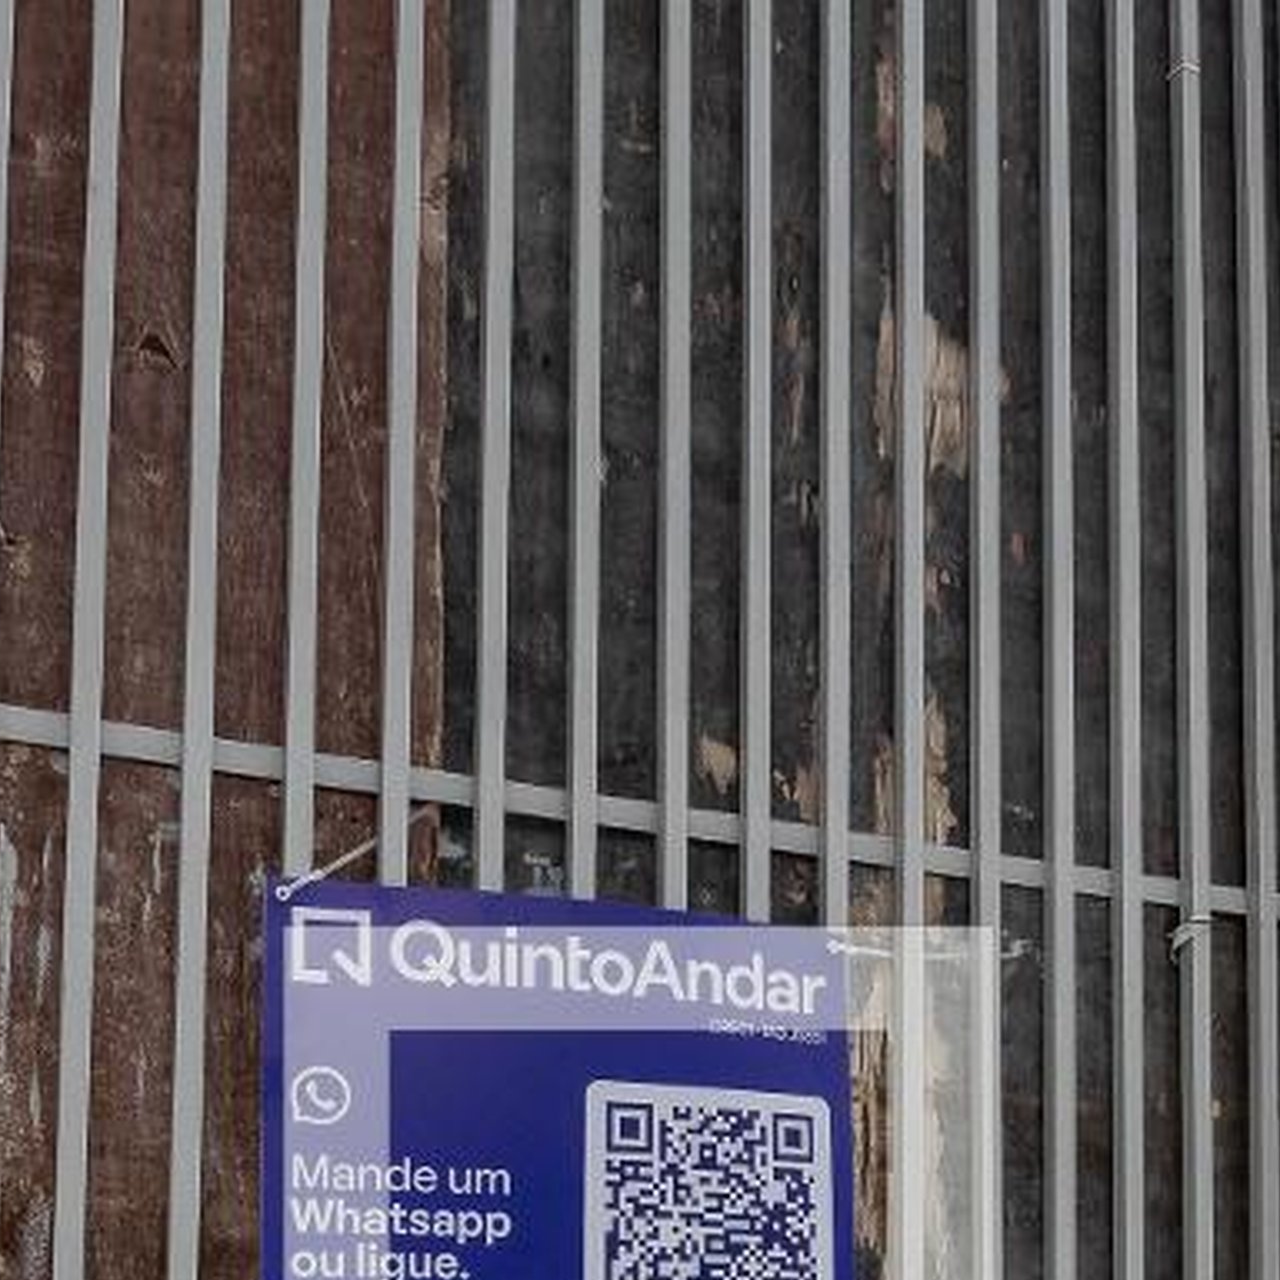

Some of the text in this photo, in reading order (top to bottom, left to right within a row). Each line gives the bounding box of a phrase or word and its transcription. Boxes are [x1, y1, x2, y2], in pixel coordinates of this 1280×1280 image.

[389, 919, 828, 1015] QuintoAndar
[291, 1152, 512, 1196] Mande um
[291, 1197, 513, 1246] Whatsapp
[291, 1251, 345, 1279] ou
